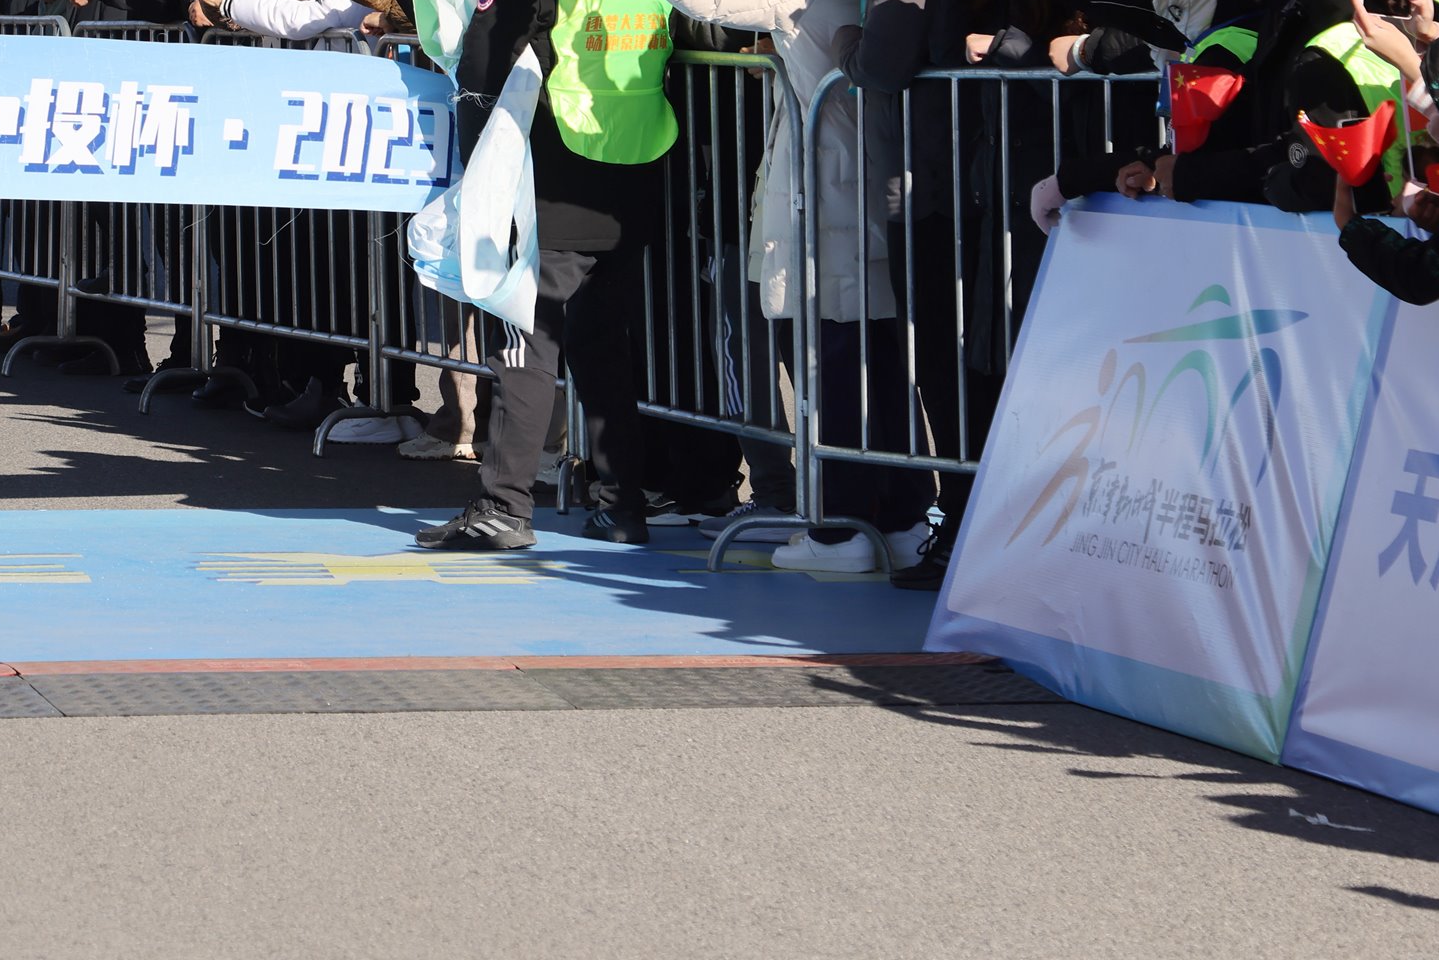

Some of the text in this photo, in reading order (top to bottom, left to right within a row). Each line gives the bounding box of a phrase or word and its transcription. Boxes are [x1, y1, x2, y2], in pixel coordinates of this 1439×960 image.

[1070, 533, 1098, 557] JING
[1097, 538, 1116, 560] JIN
[1117, 541, 1142, 566] CITY
[1143, 549, 1172, 574] HALF
